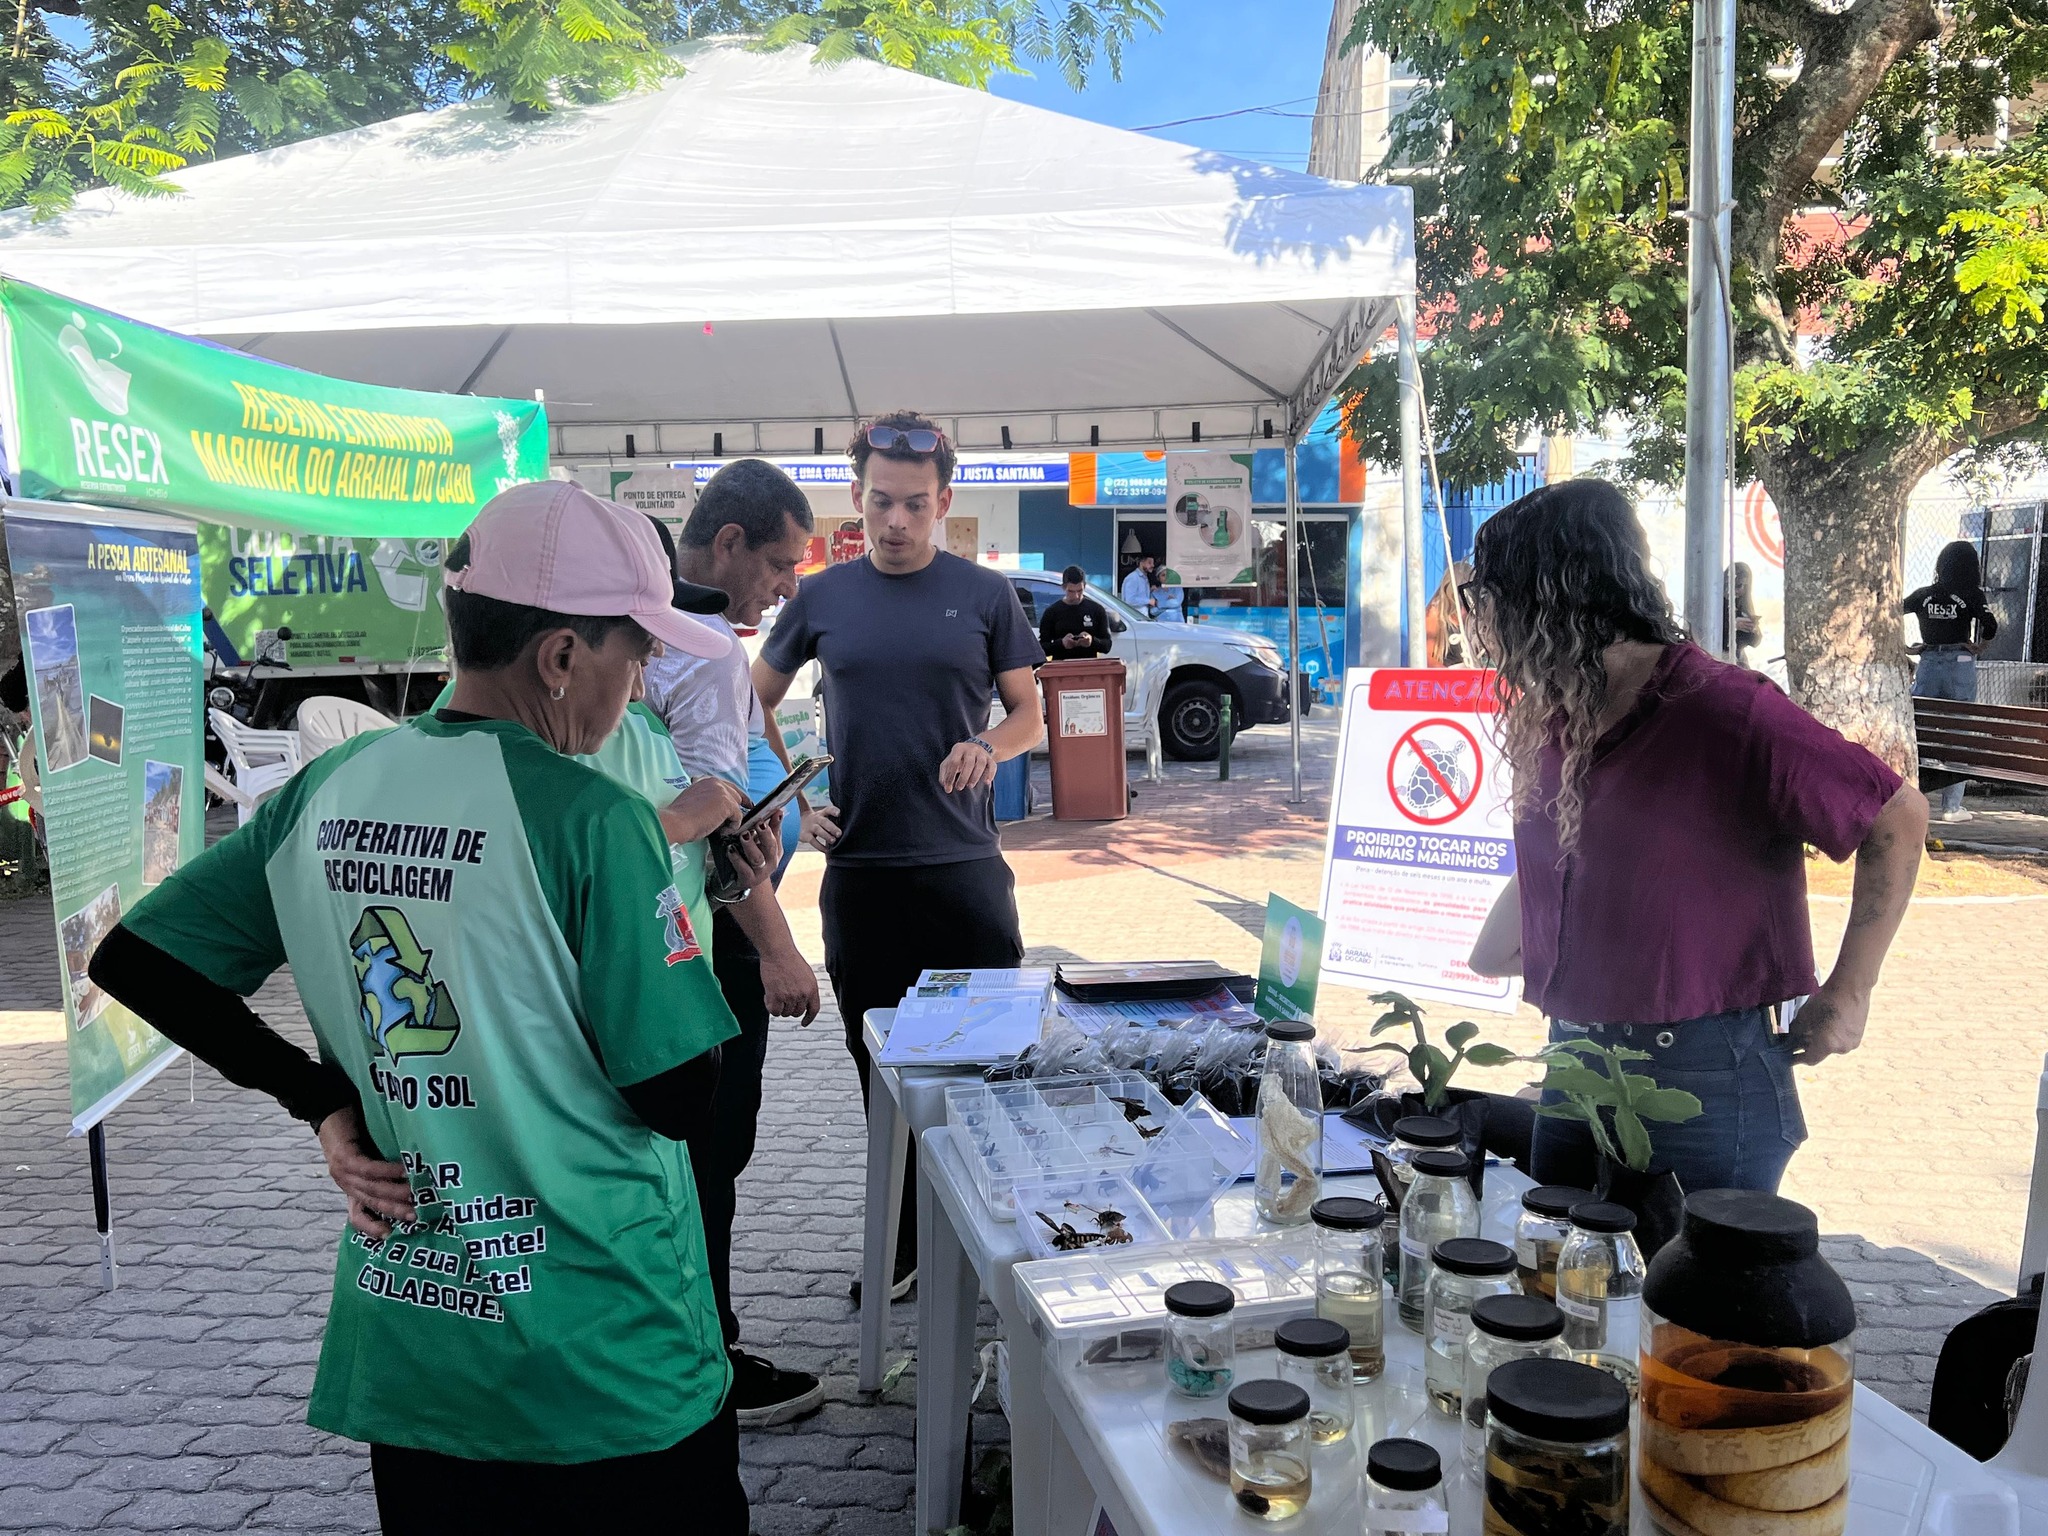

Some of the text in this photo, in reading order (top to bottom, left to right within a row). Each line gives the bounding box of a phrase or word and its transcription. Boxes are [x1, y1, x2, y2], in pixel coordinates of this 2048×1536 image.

[232, 381, 453, 455] RESERVA EXTRATIVISTA
[70, 417, 170, 485] RESEX
[191, 430, 475, 504] MARINHA DO ARRAIAL DO CABO
[799, 467, 822, 480] UMA
[963, 467, 995, 481] JUSTA
[996, 467, 1045, 481] SANTANA
[624, 491, 686, 500] PONTO DE ENTREGA
[635, 499, 675, 509] VOLUNTÁRIO
[1113, 488, 1166, 496] 022 3318-094
[88, 543, 190, 574] A PESCA ARTESANAL
[229, 552, 368, 597] SELETIVA
[1927, 603, 1957, 615] RESEX
[1385, 677, 1499, 706] ATENÇÃO
[317, 819, 487, 864] COOPERATIVA DE
[1346, 830, 1507, 857] PROIBIDO TOCAR NOS
[1354, 845, 1499, 870] ANIMAIS MARINHOS
[324, 859, 454, 902] RECICLAGEM
[1374, 868, 1400, 877] detenção
[1345, 949, 1373, 959] ARRAIAL
[1450, 959, 1469, 968] DEN
[427, 1074, 476, 1108] SOL
[410, 1246, 460, 1276] sua
